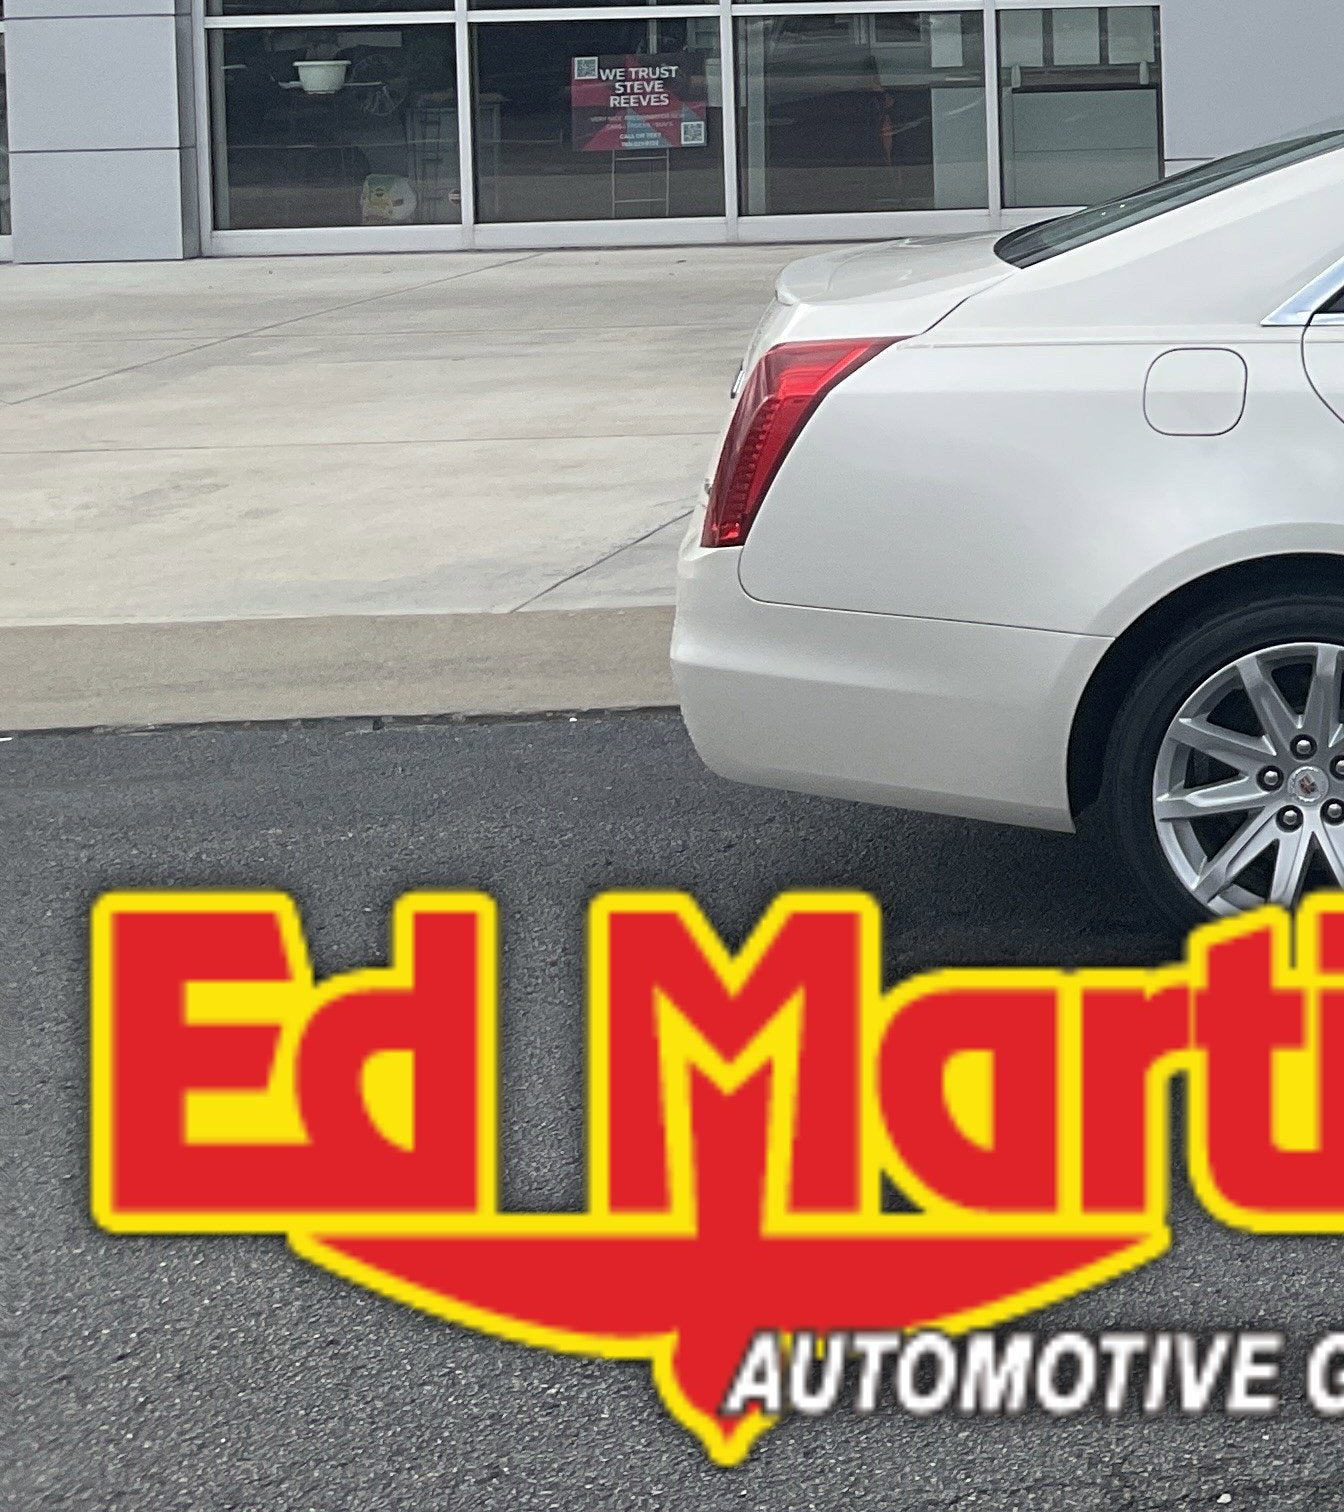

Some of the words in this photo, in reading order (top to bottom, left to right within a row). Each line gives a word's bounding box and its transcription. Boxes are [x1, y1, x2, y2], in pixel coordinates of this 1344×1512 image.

[600, 68, 625, 80] WE
[628, 66, 679, 79] TRUST
[615, 80, 664, 94] STEVE
[609, 94, 669, 107] REEVES
